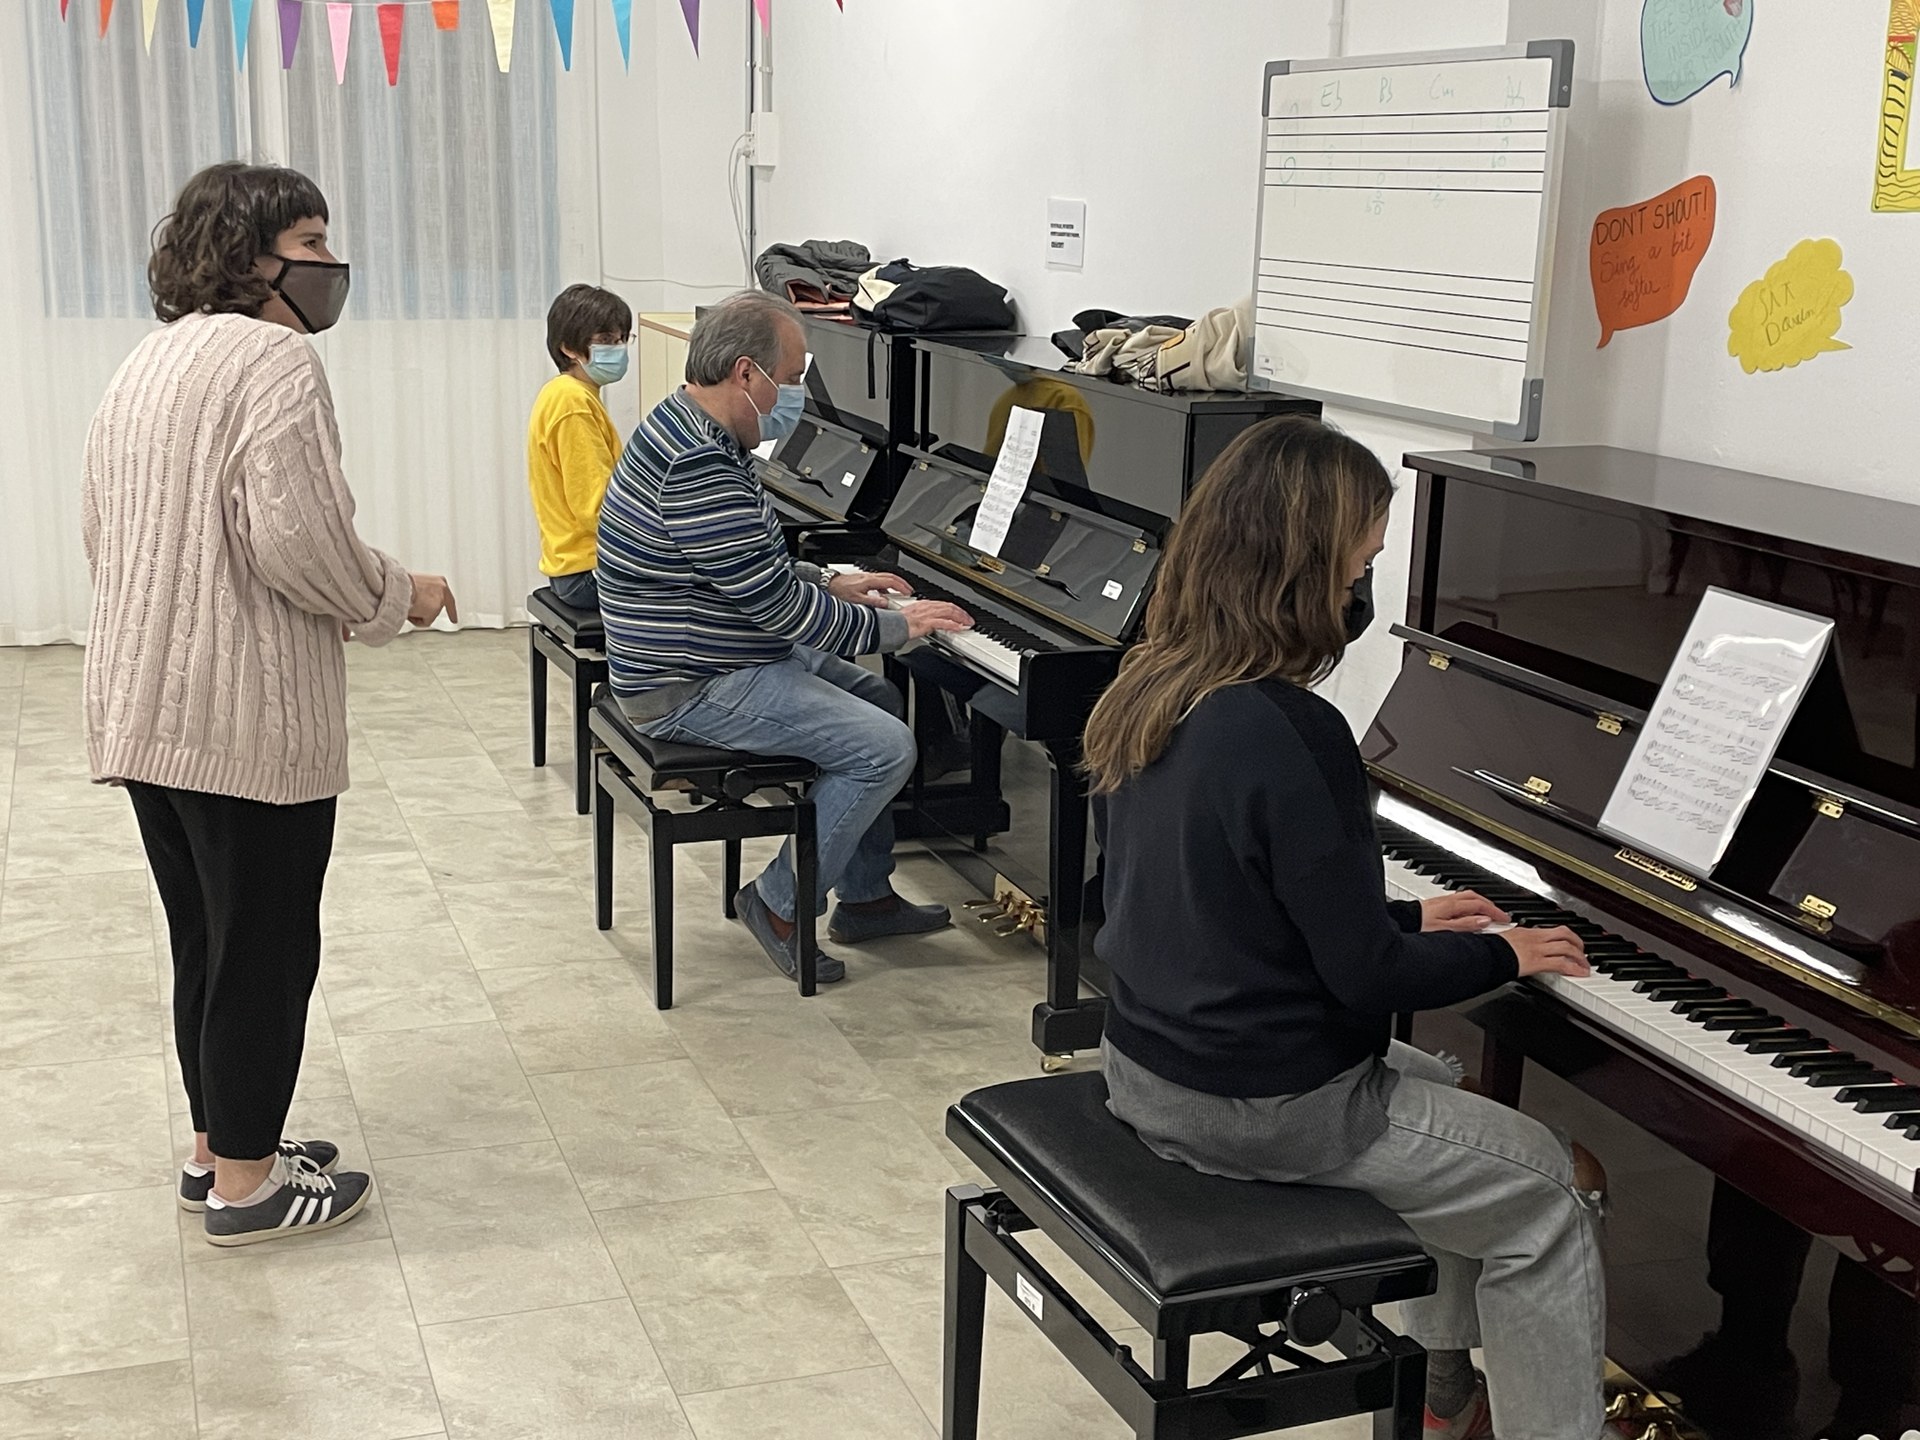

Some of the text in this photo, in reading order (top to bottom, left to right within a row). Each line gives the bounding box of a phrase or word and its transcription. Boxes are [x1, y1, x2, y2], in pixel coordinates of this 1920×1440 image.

[1595, 186, 1709, 246] DON'T SHOUT!
[1600, 229, 1696, 285] Sing a bit
